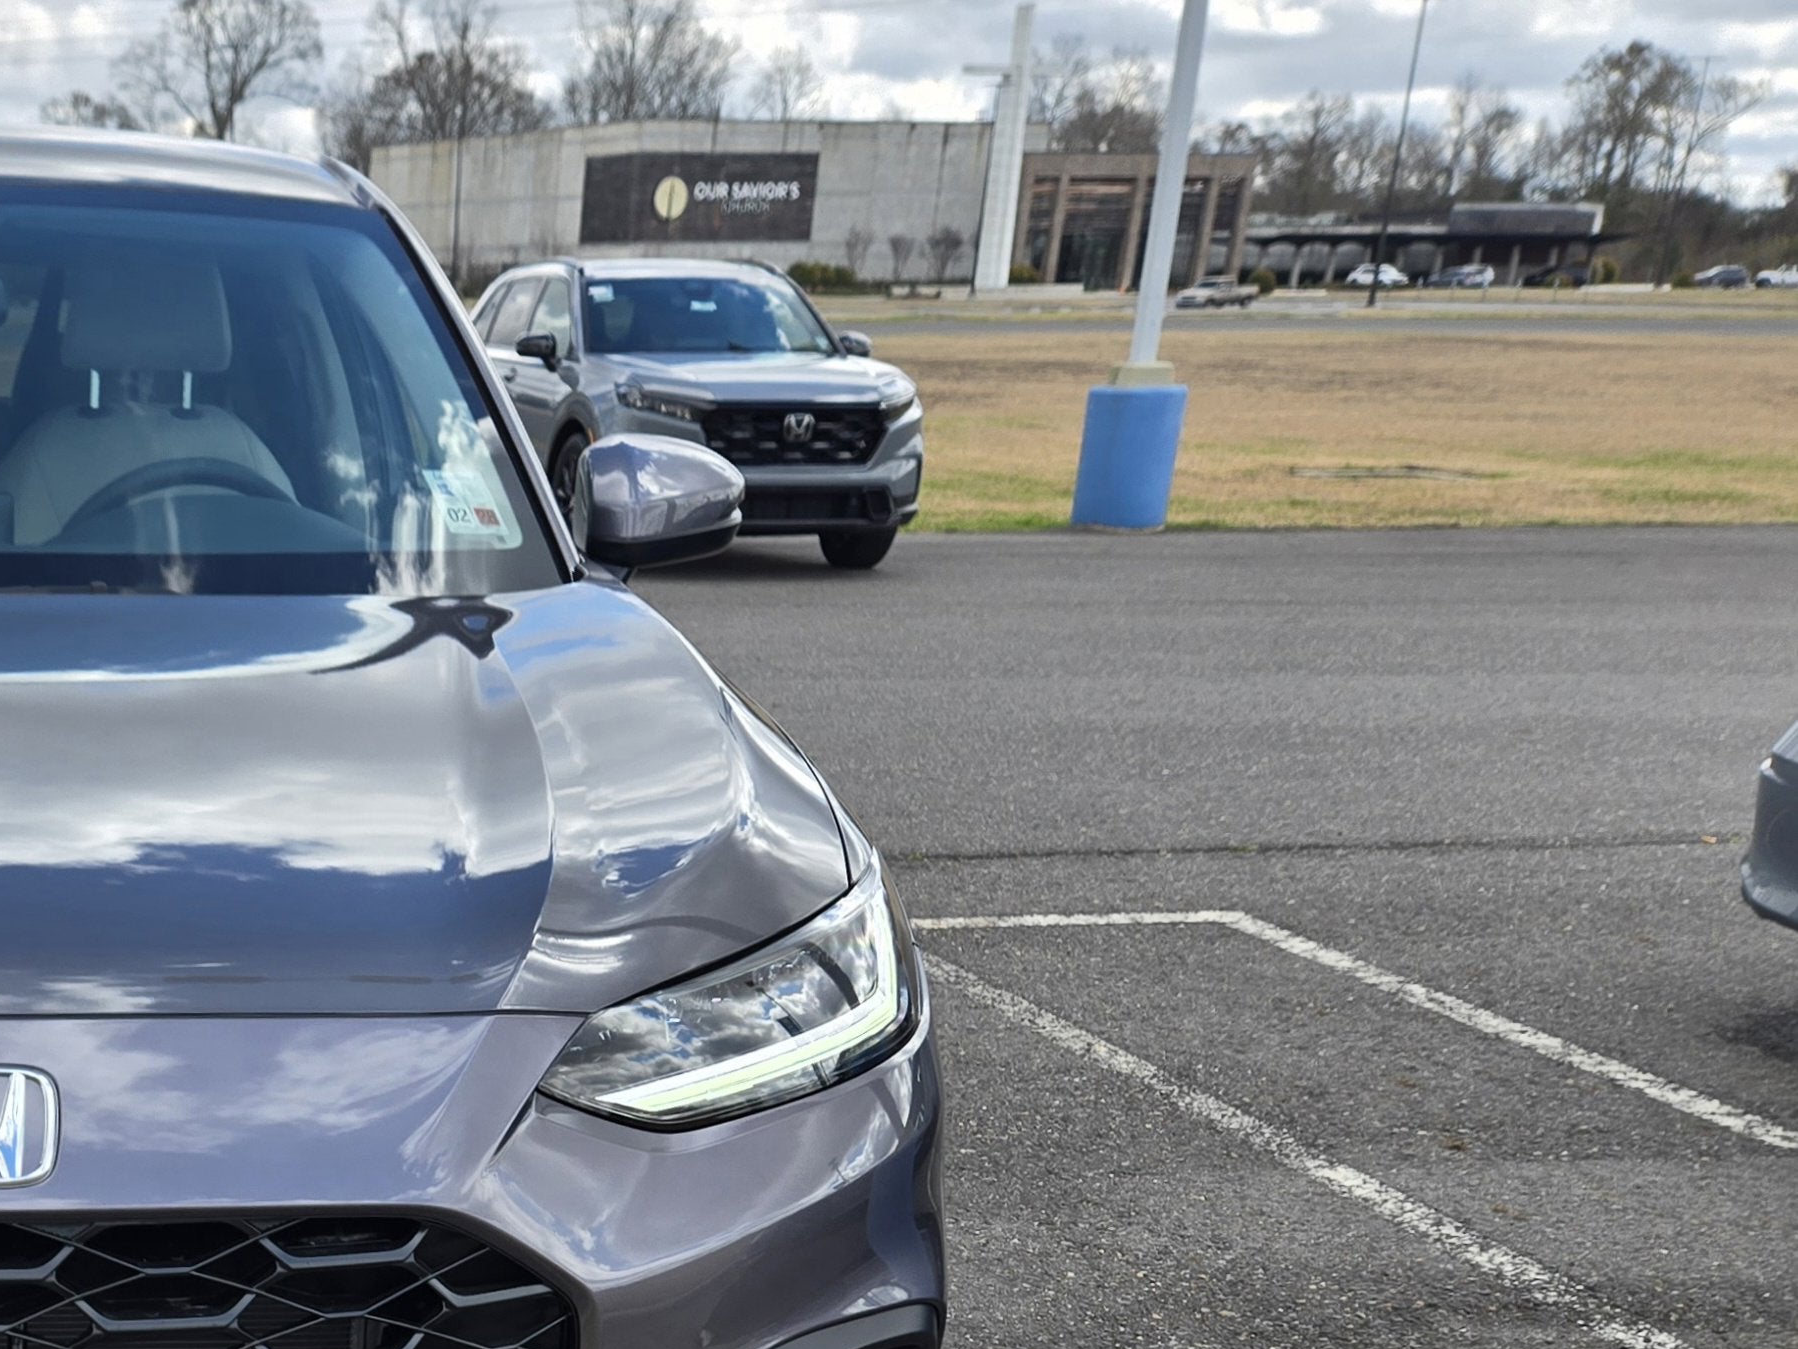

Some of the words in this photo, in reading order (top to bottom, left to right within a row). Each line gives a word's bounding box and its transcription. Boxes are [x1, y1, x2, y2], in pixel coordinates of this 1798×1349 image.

[693, 181, 730, 201] OUR
[731, 181, 800, 201] SAVIOR'S
[447, 507, 472, 523] 02
